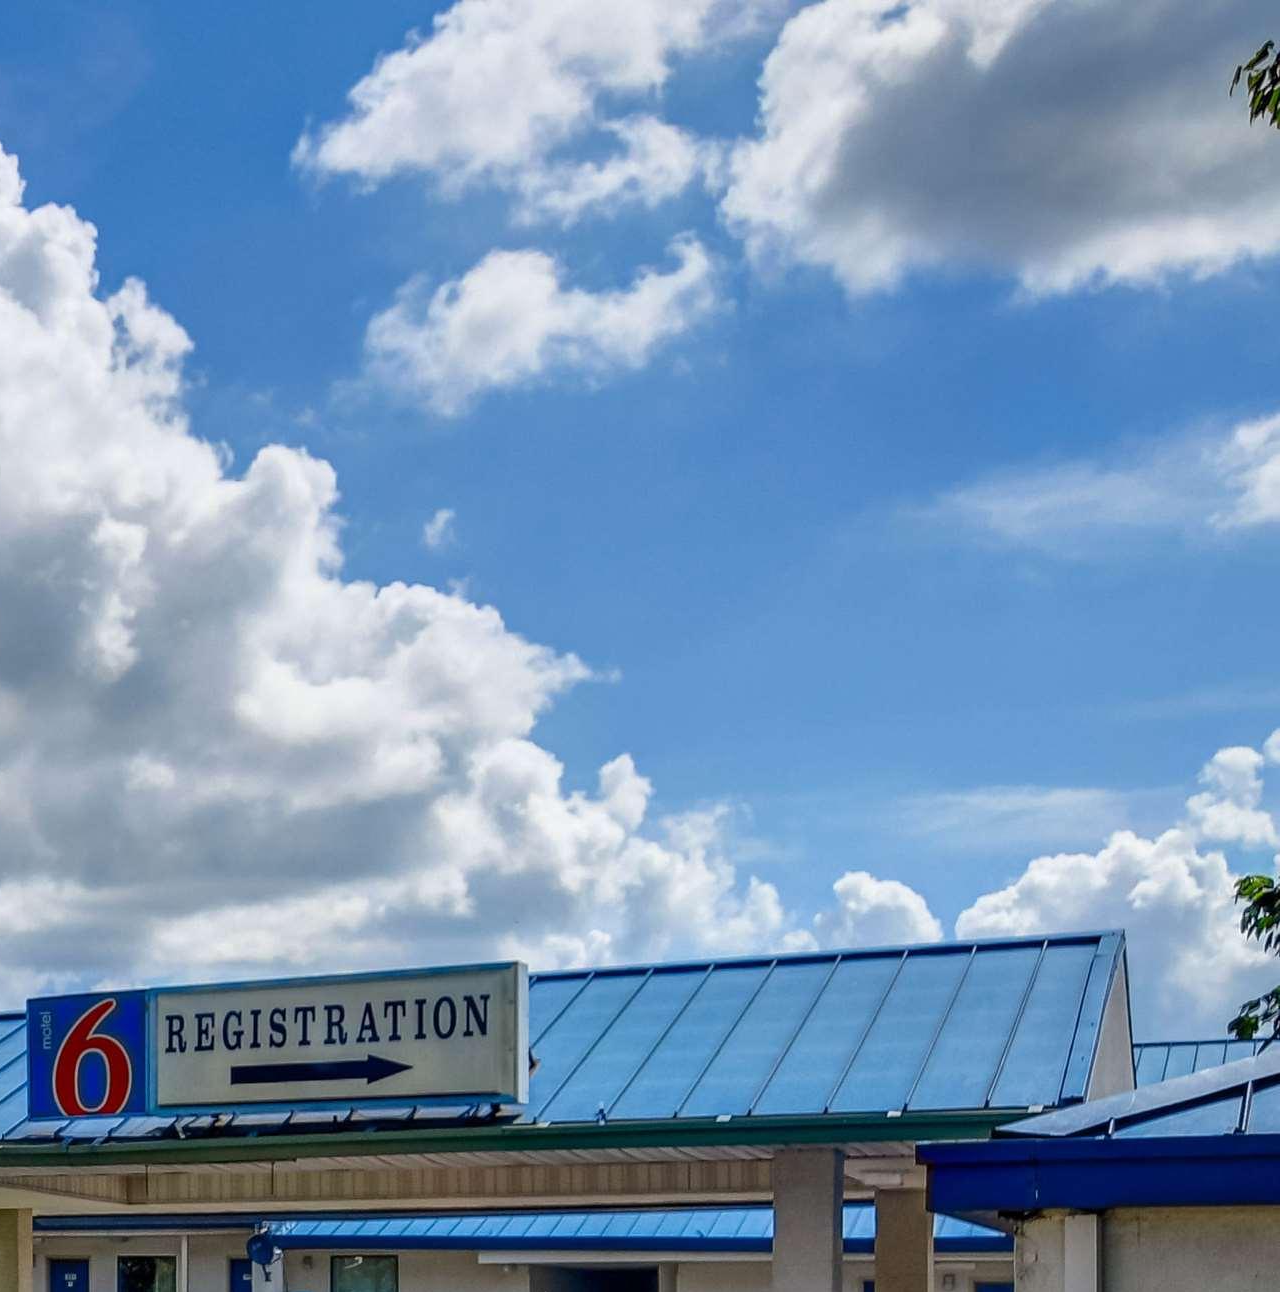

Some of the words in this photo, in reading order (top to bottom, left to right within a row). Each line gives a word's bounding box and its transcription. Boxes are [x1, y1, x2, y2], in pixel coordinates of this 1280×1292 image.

[40, 1011, 53, 1050] motel
[164, 994, 491, 1054] REGISTRATION
[52, 998, 133, 1117] 6
